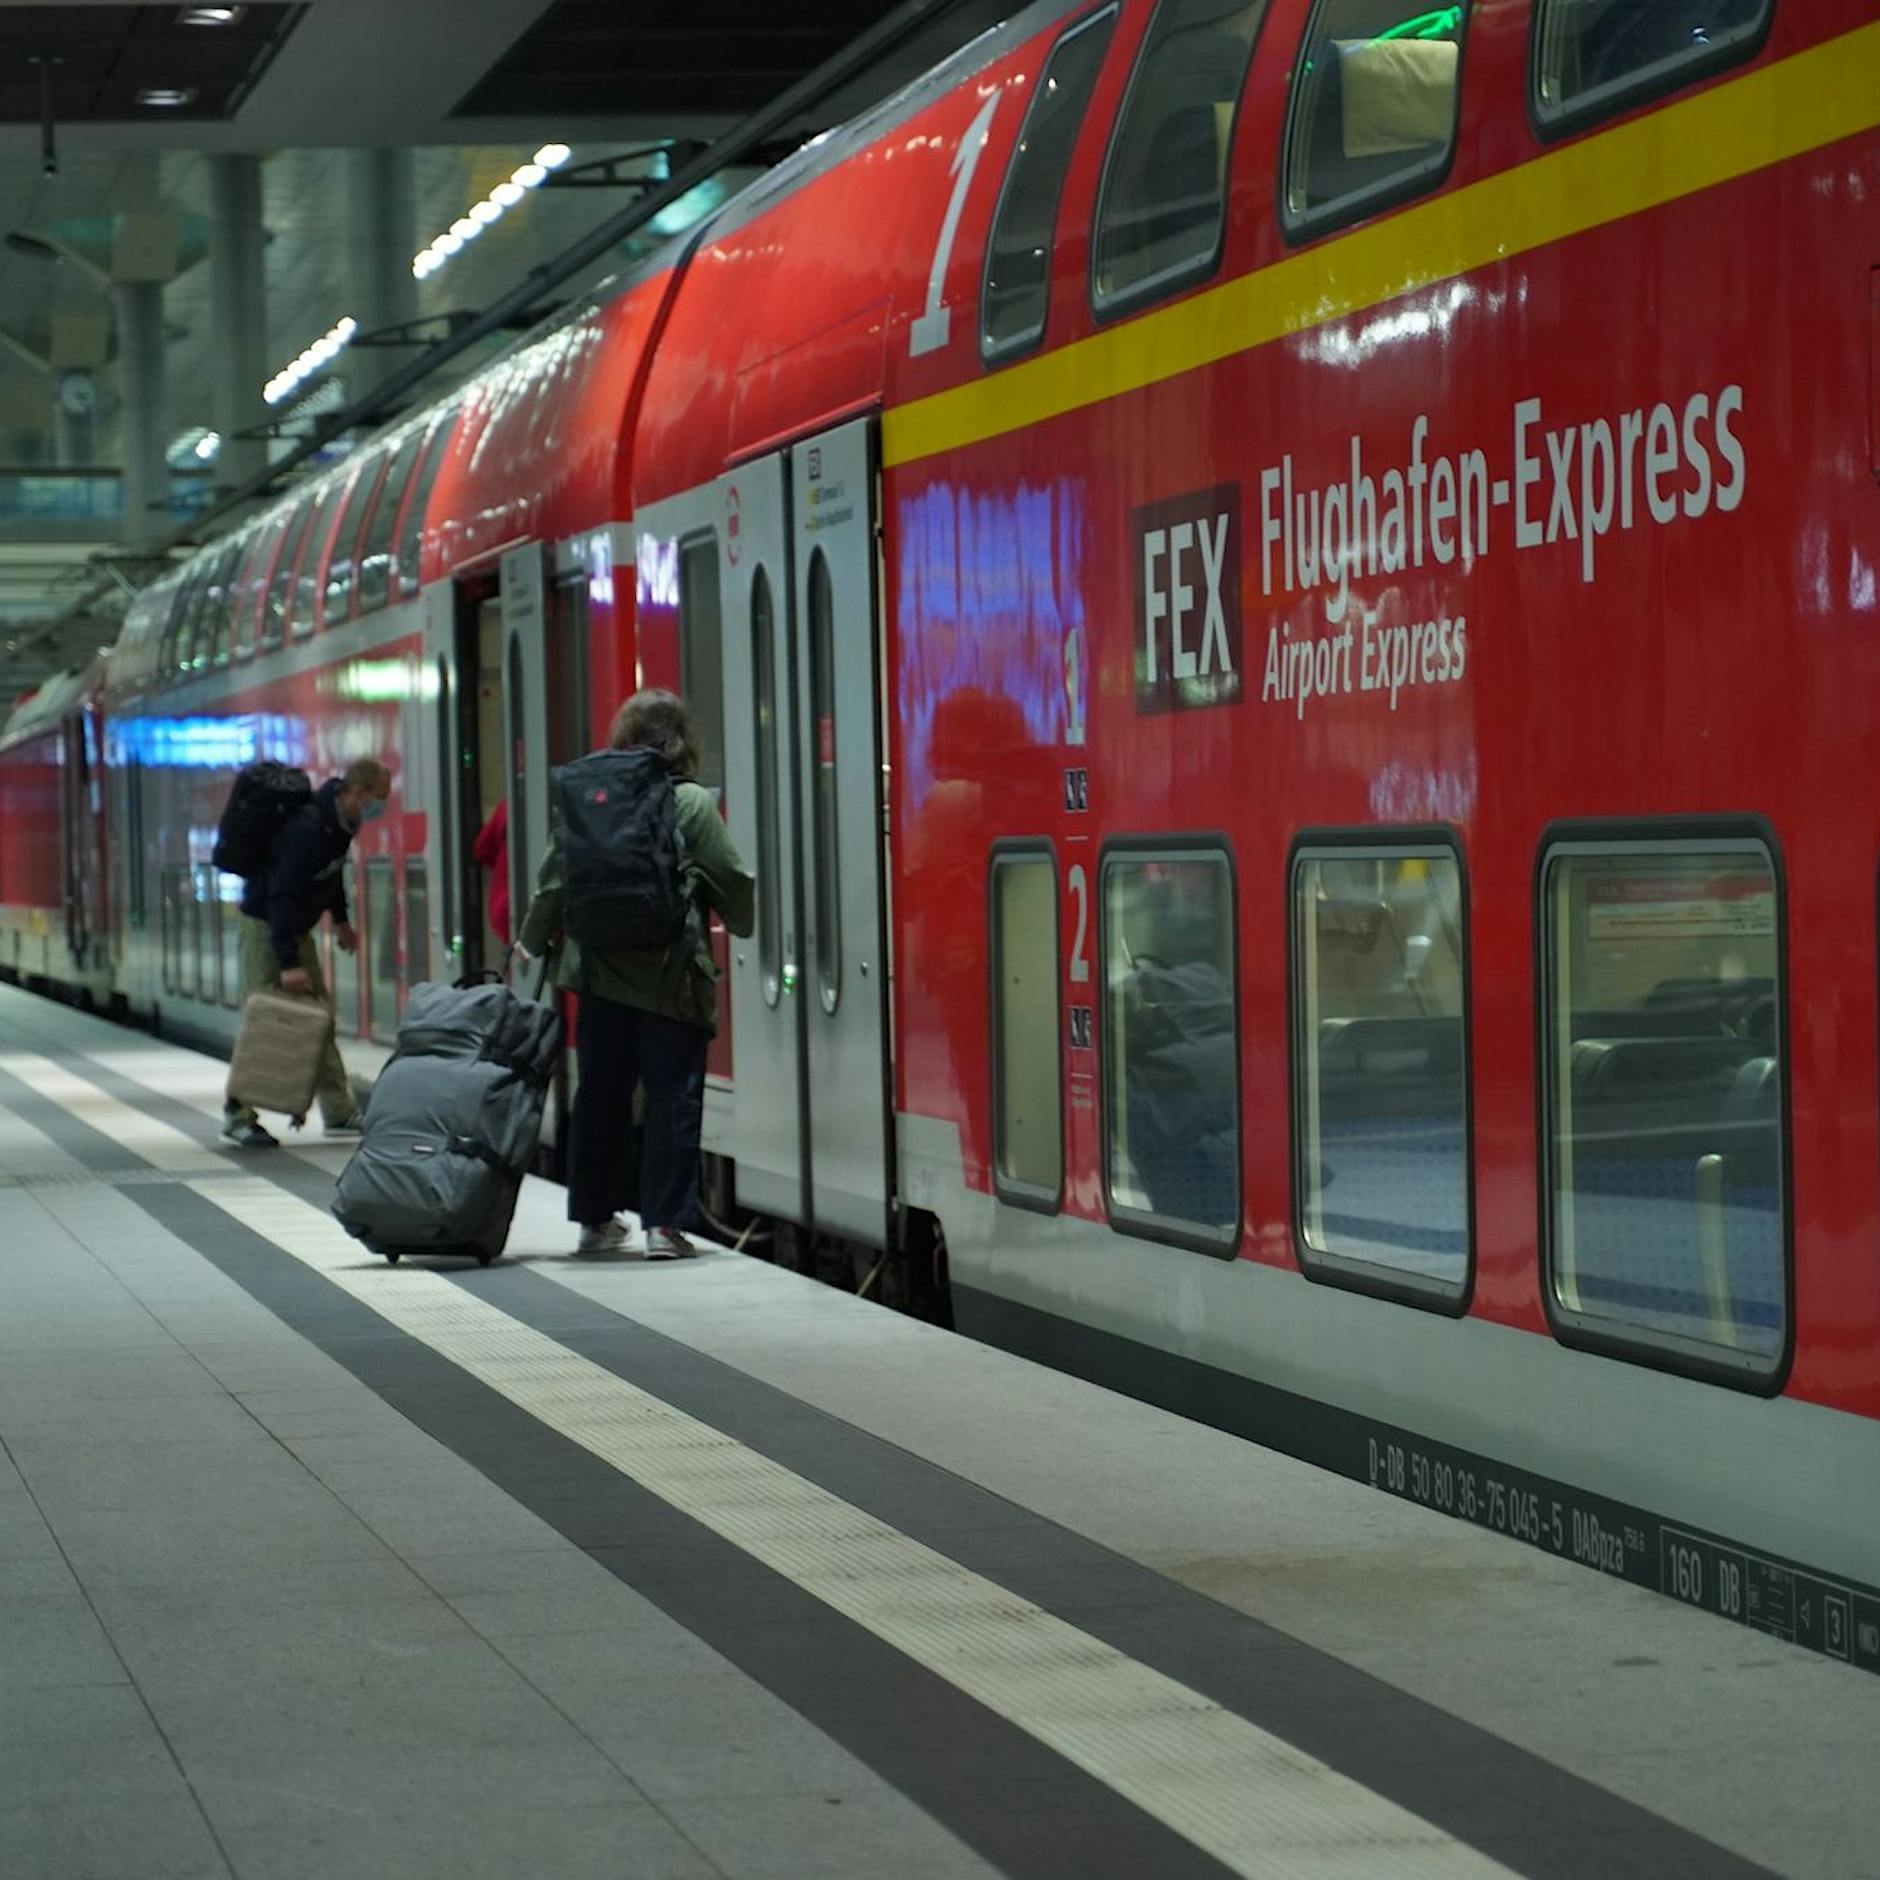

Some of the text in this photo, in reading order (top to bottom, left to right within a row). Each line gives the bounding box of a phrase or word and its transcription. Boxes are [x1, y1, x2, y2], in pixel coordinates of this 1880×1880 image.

[909, 87, 1001, 357] 1
[1261, 385, 1746, 623] Flughafen-Express
[1144, 513, 1233, 683] FEX
[1064, 627, 1086, 745] 1
[1262, 611, 1467, 720] Airport Express
[1069, 864, 1088, 983] 2
[1369, 1438, 1405, 1491] D-DB
[1412, 1452, 1431, 1500] 50
[1435, 1461, 1454, 1509] 80
[1458, 1469, 1505, 1529] 36-75
[1509, 1488, 1564, 1550] 045-5
[1670, 1545, 1740, 1615] 160 DB
[1831, 1609, 1841, 1645] 3
